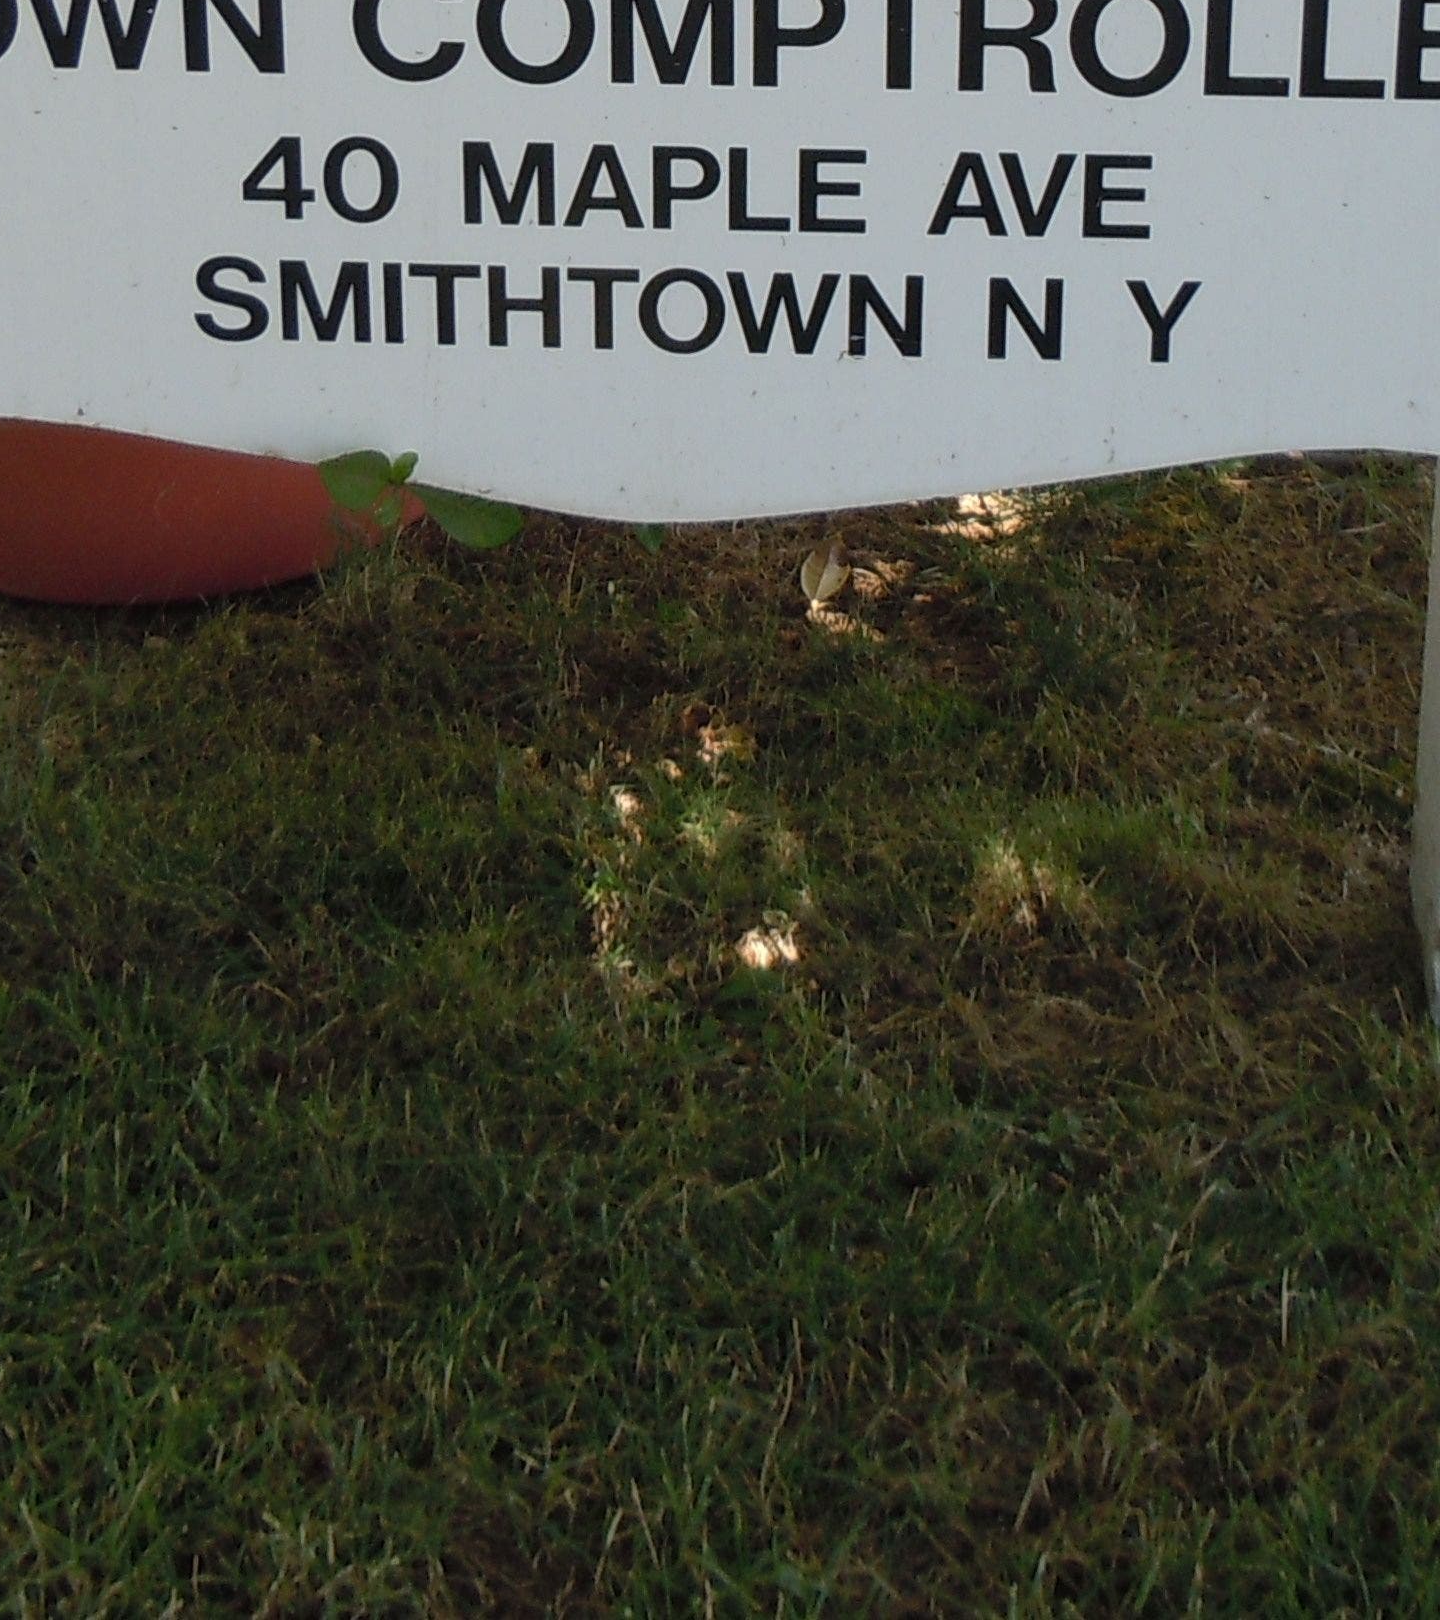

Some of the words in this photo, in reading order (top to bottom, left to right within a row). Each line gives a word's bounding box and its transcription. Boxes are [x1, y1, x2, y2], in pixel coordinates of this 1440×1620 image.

[243, 137, 399, 223] 40
[463, 142, 866, 233] MAPLE
[927, 152, 1152, 239] AVE
[195, 256, 923, 357] SMITHTOWN
[988, 278, 1063, 360] N
[1126, 280, 1201, 362] Y
